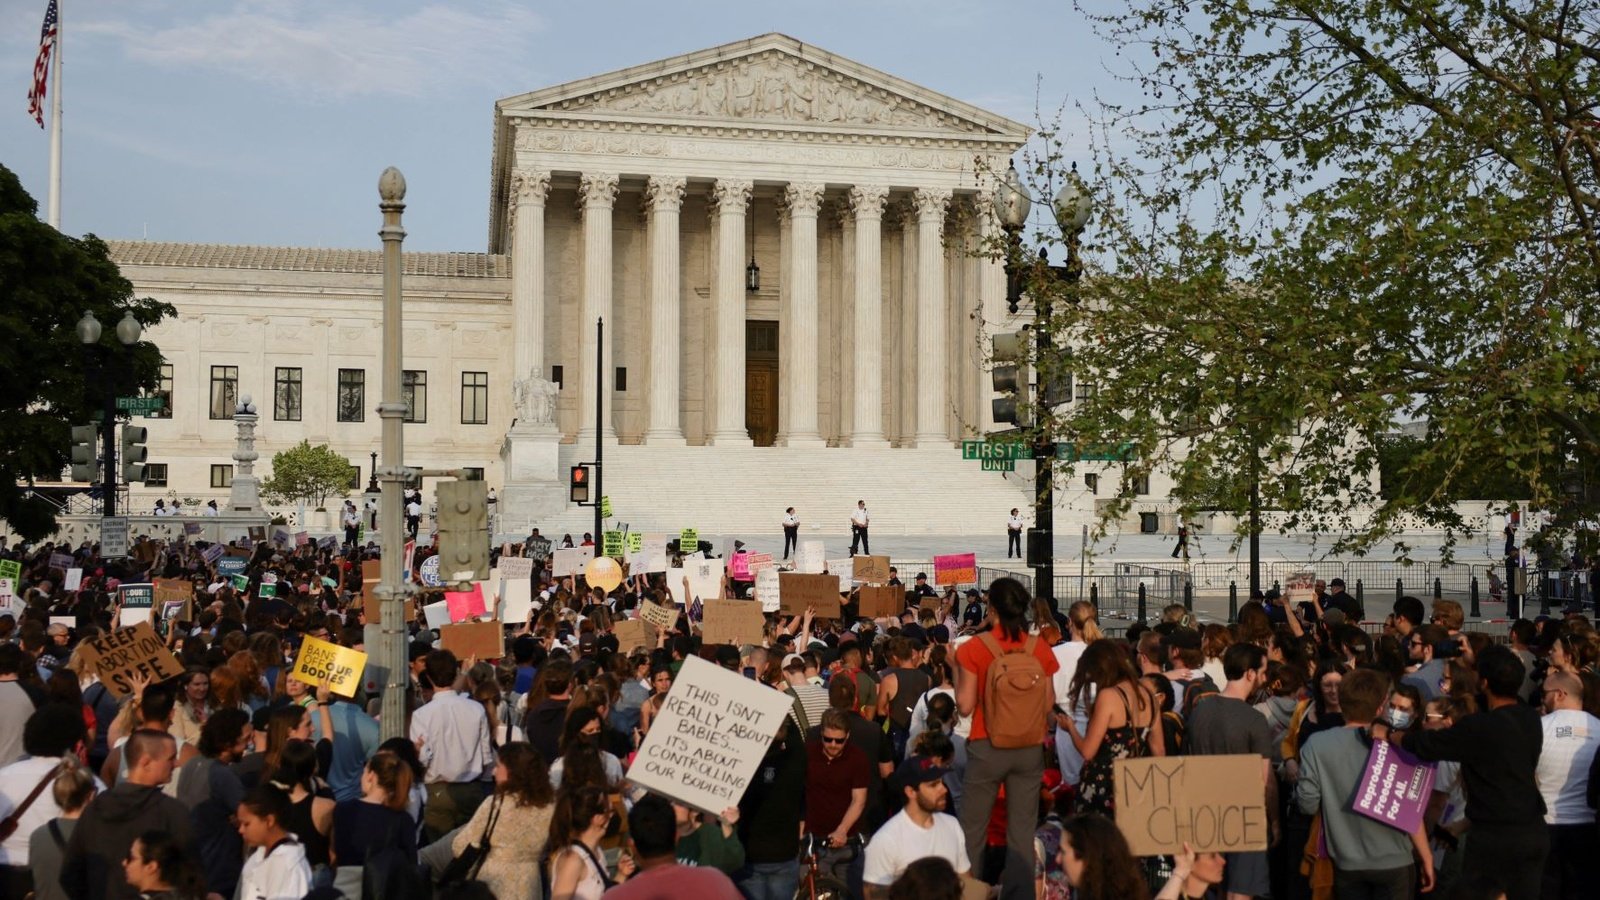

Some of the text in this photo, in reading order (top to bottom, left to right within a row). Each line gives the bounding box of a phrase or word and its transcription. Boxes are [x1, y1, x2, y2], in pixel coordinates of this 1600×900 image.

[119, 398, 152, 409] FIRST
[129, 408, 150, 416] UNIT
[965, 443, 1015, 458] FIRST
[983, 460, 1014, 471] UNIT
[91, 626, 138, 656] KEEP
[95, 637, 165, 677] ABORTION
[306, 644, 338, 662] BANS
[300, 663, 346, 685] BODIES
[303, 654, 353, 677] OFF OUR
[686, 683, 720, 707] THIS
[666, 695, 773, 747] REALLY ABOUT
[677, 719, 741, 754] BABIES...
[648, 744, 745, 788] CONTROLLING
[694, 747, 743, 770] ABOUT
[645, 761, 735, 800] OUR BODIES!
[1123, 763, 1185, 808] MY
[1359, 740, 1390, 810] Reproductiv
[1373, 763, 1398, 815] Freedom
[1386, 780, 1408, 820] For All.
[1147, 804, 1267, 849] CHOICE
